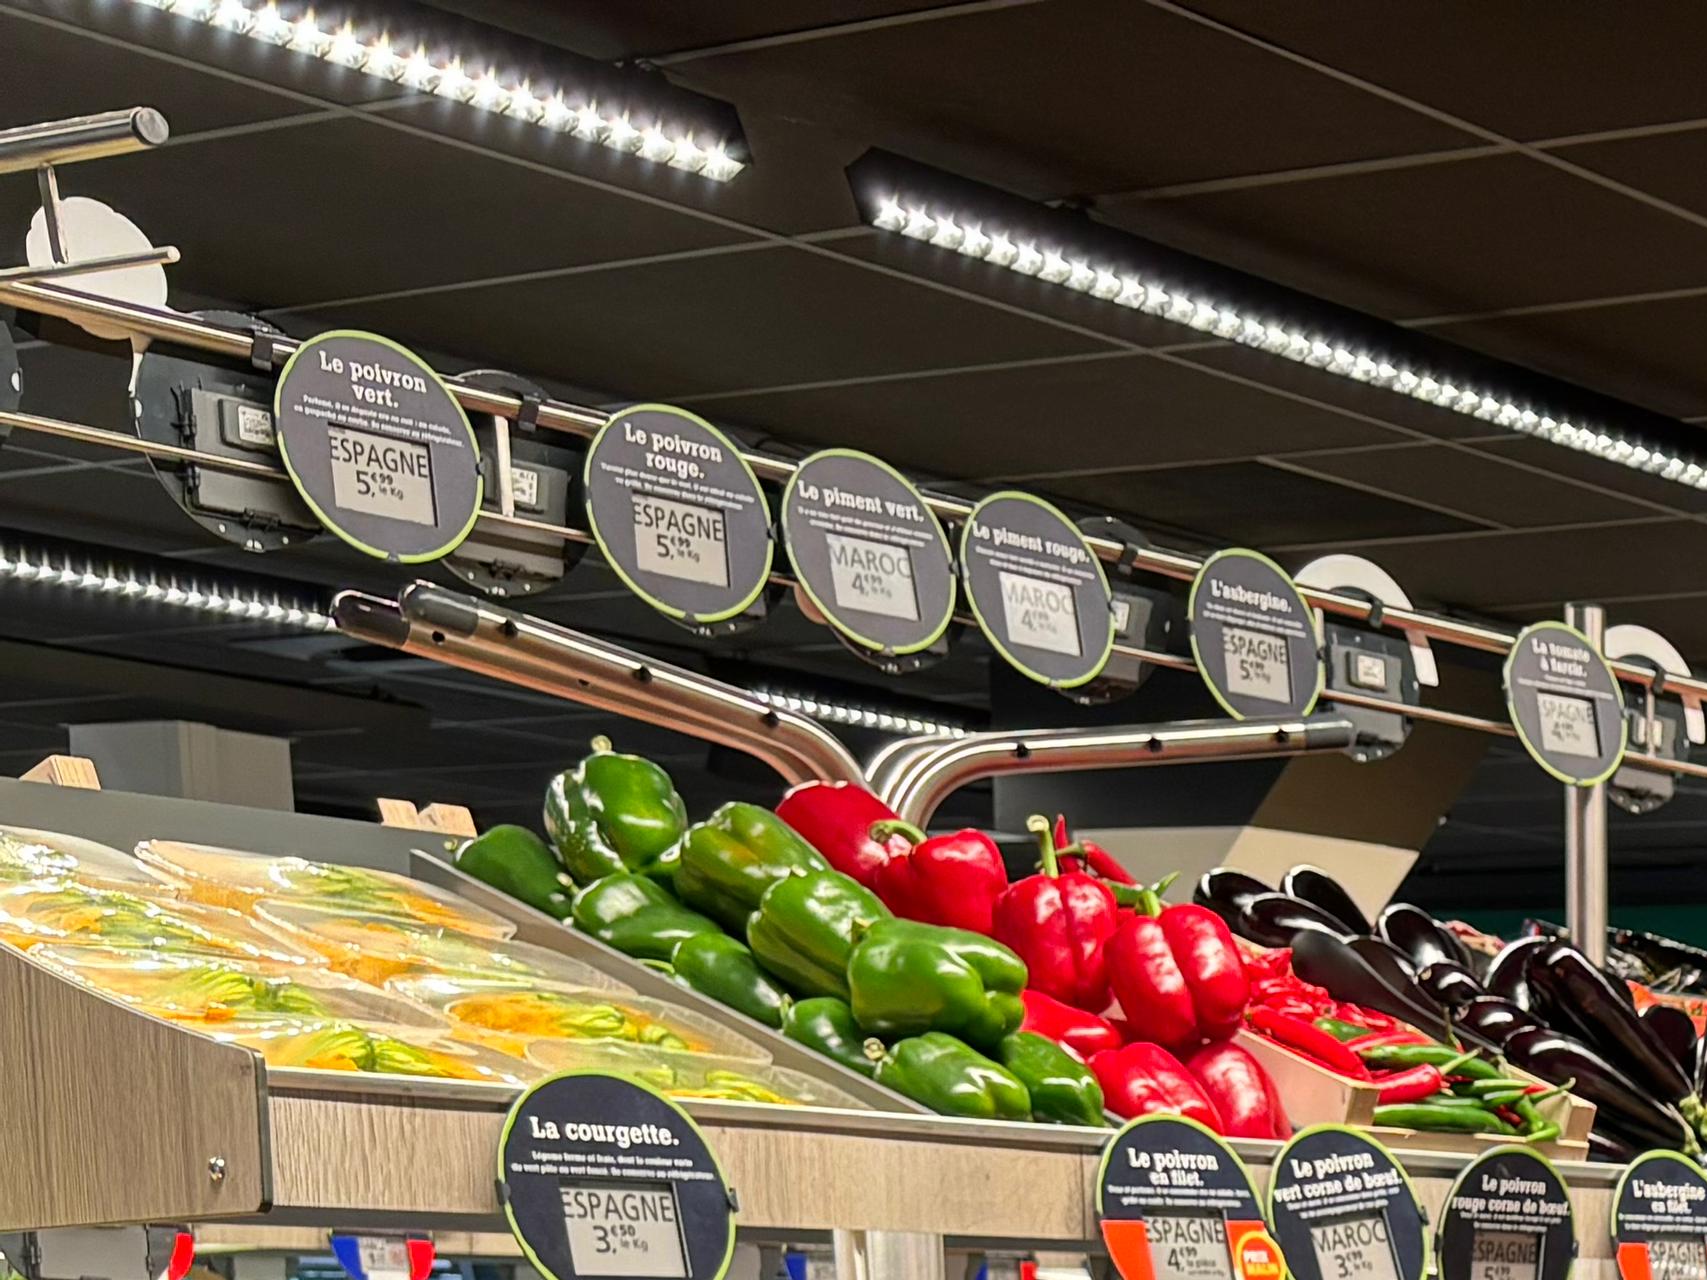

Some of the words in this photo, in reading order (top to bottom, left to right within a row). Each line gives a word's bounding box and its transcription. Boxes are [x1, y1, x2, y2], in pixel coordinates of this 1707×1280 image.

[319, 350, 344, 374] Le
[350, 361, 427, 393] poivron
[352, 383, 399, 408] vert.
[624, 422, 647, 445] Le
[652, 433, 722, 463] poivron
[645, 452, 705, 479] rouge.
[797, 480, 819, 500] Le
[822, 487, 882, 513] piment
[885, 501, 925, 522] vert.
[971, 520, 990, 540] Le
[992, 527, 1043, 552] piment
[1045, 541, 1090, 564] rouge.
[1210, 579, 1292, 613] L'aubergine.
[529, 1116, 560, 1140] La
[565, 1119, 680, 1149] courgette.
[1127, 1147, 1150, 1169] Le
[1152, 1149, 1219, 1173] poivron
[1291, 1159, 1313, 1178] Le
[1314, 1153, 1374, 1179] poivron
[1149, 1170, 1170, 1186] en
[1170, 1170, 1204, 1187] filet.
[1274, 1184, 1302, 1203] vert
[1303, 1180, 1343, 1198] corne
[1344, 1174, 1362, 1192] de
[1482, 1174, 1498, 1192] Le
[1499, 1177, 1546, 1196] poivron
[561, 1190, 675, 1223] ESPAGNE
[1452, 1195, 1487, 1212] rouge
[1488, 1198, 1521, 1214] corne
[1522, 1200, 1538, 1214] de
[633, 1238, 649, 1253] Kg
